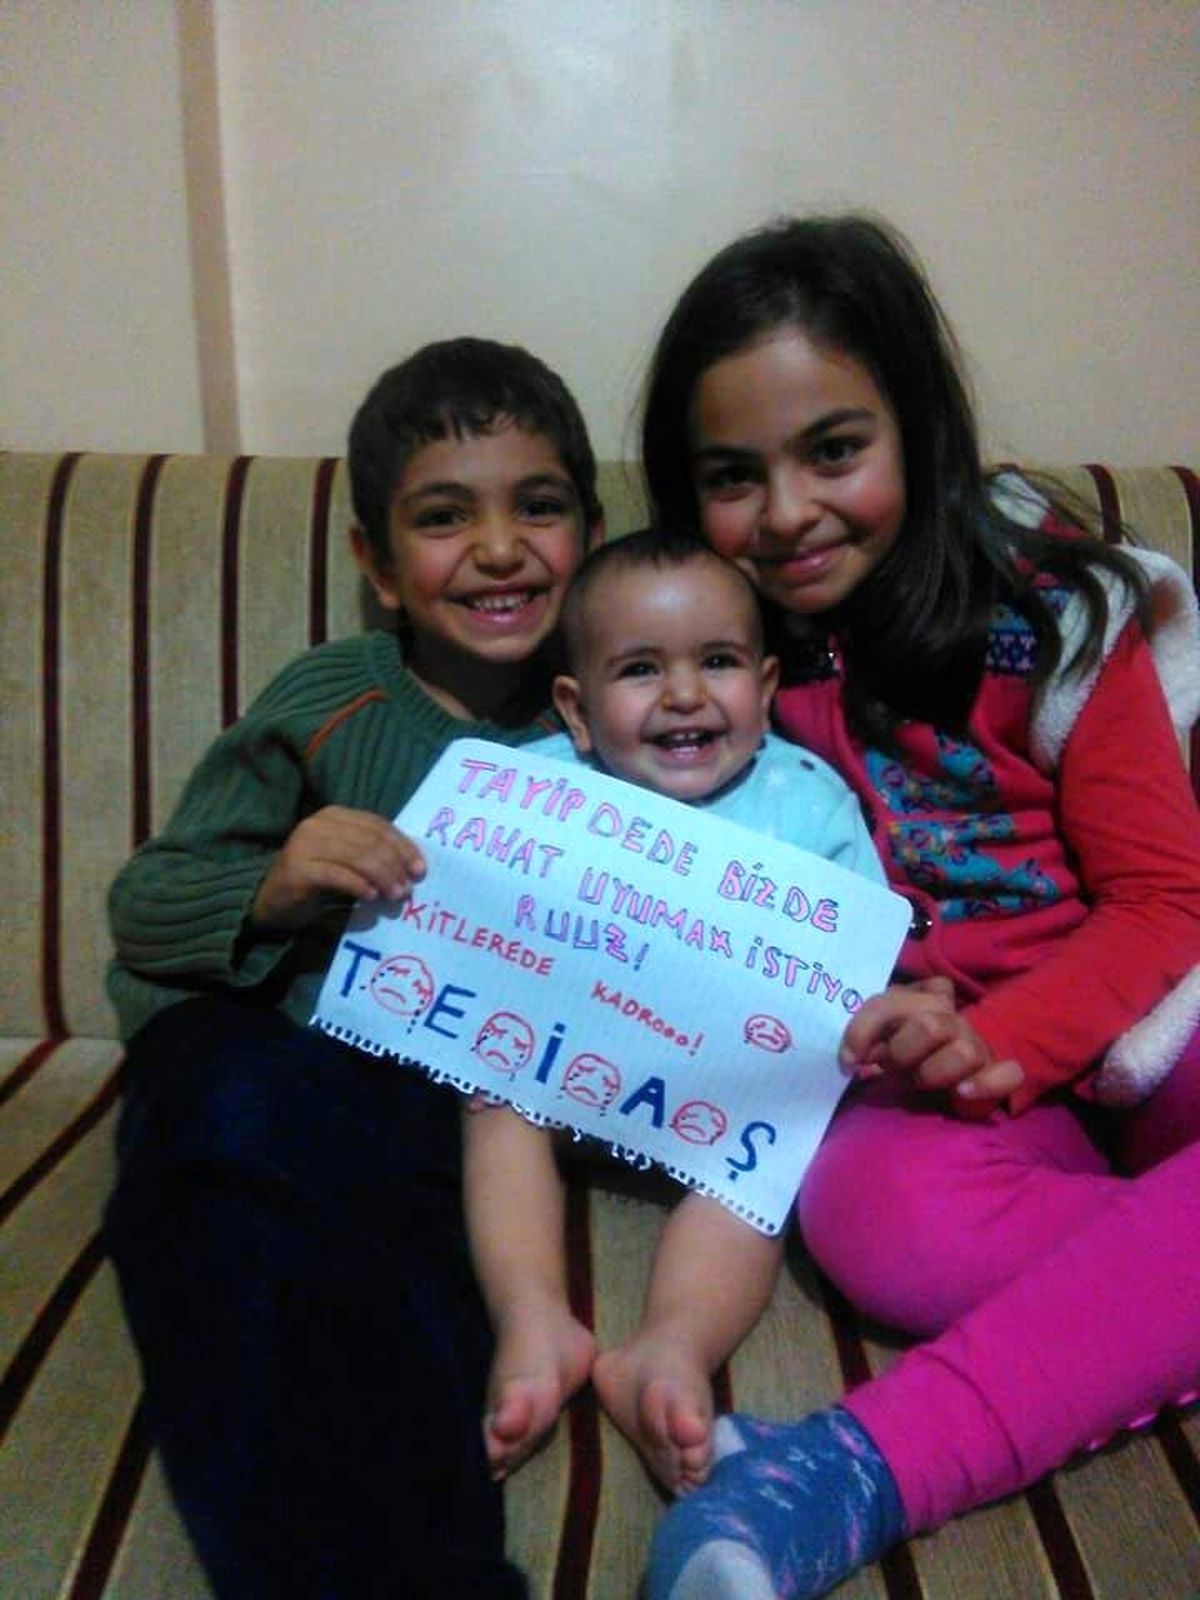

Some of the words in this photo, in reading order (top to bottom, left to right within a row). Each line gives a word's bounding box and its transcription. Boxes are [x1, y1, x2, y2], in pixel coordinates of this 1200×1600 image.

[425, 806, 565, 878] RAHAT
[577, 866, 733, 959] UYUMAK
[587, 801, 699, 877] DEDE
